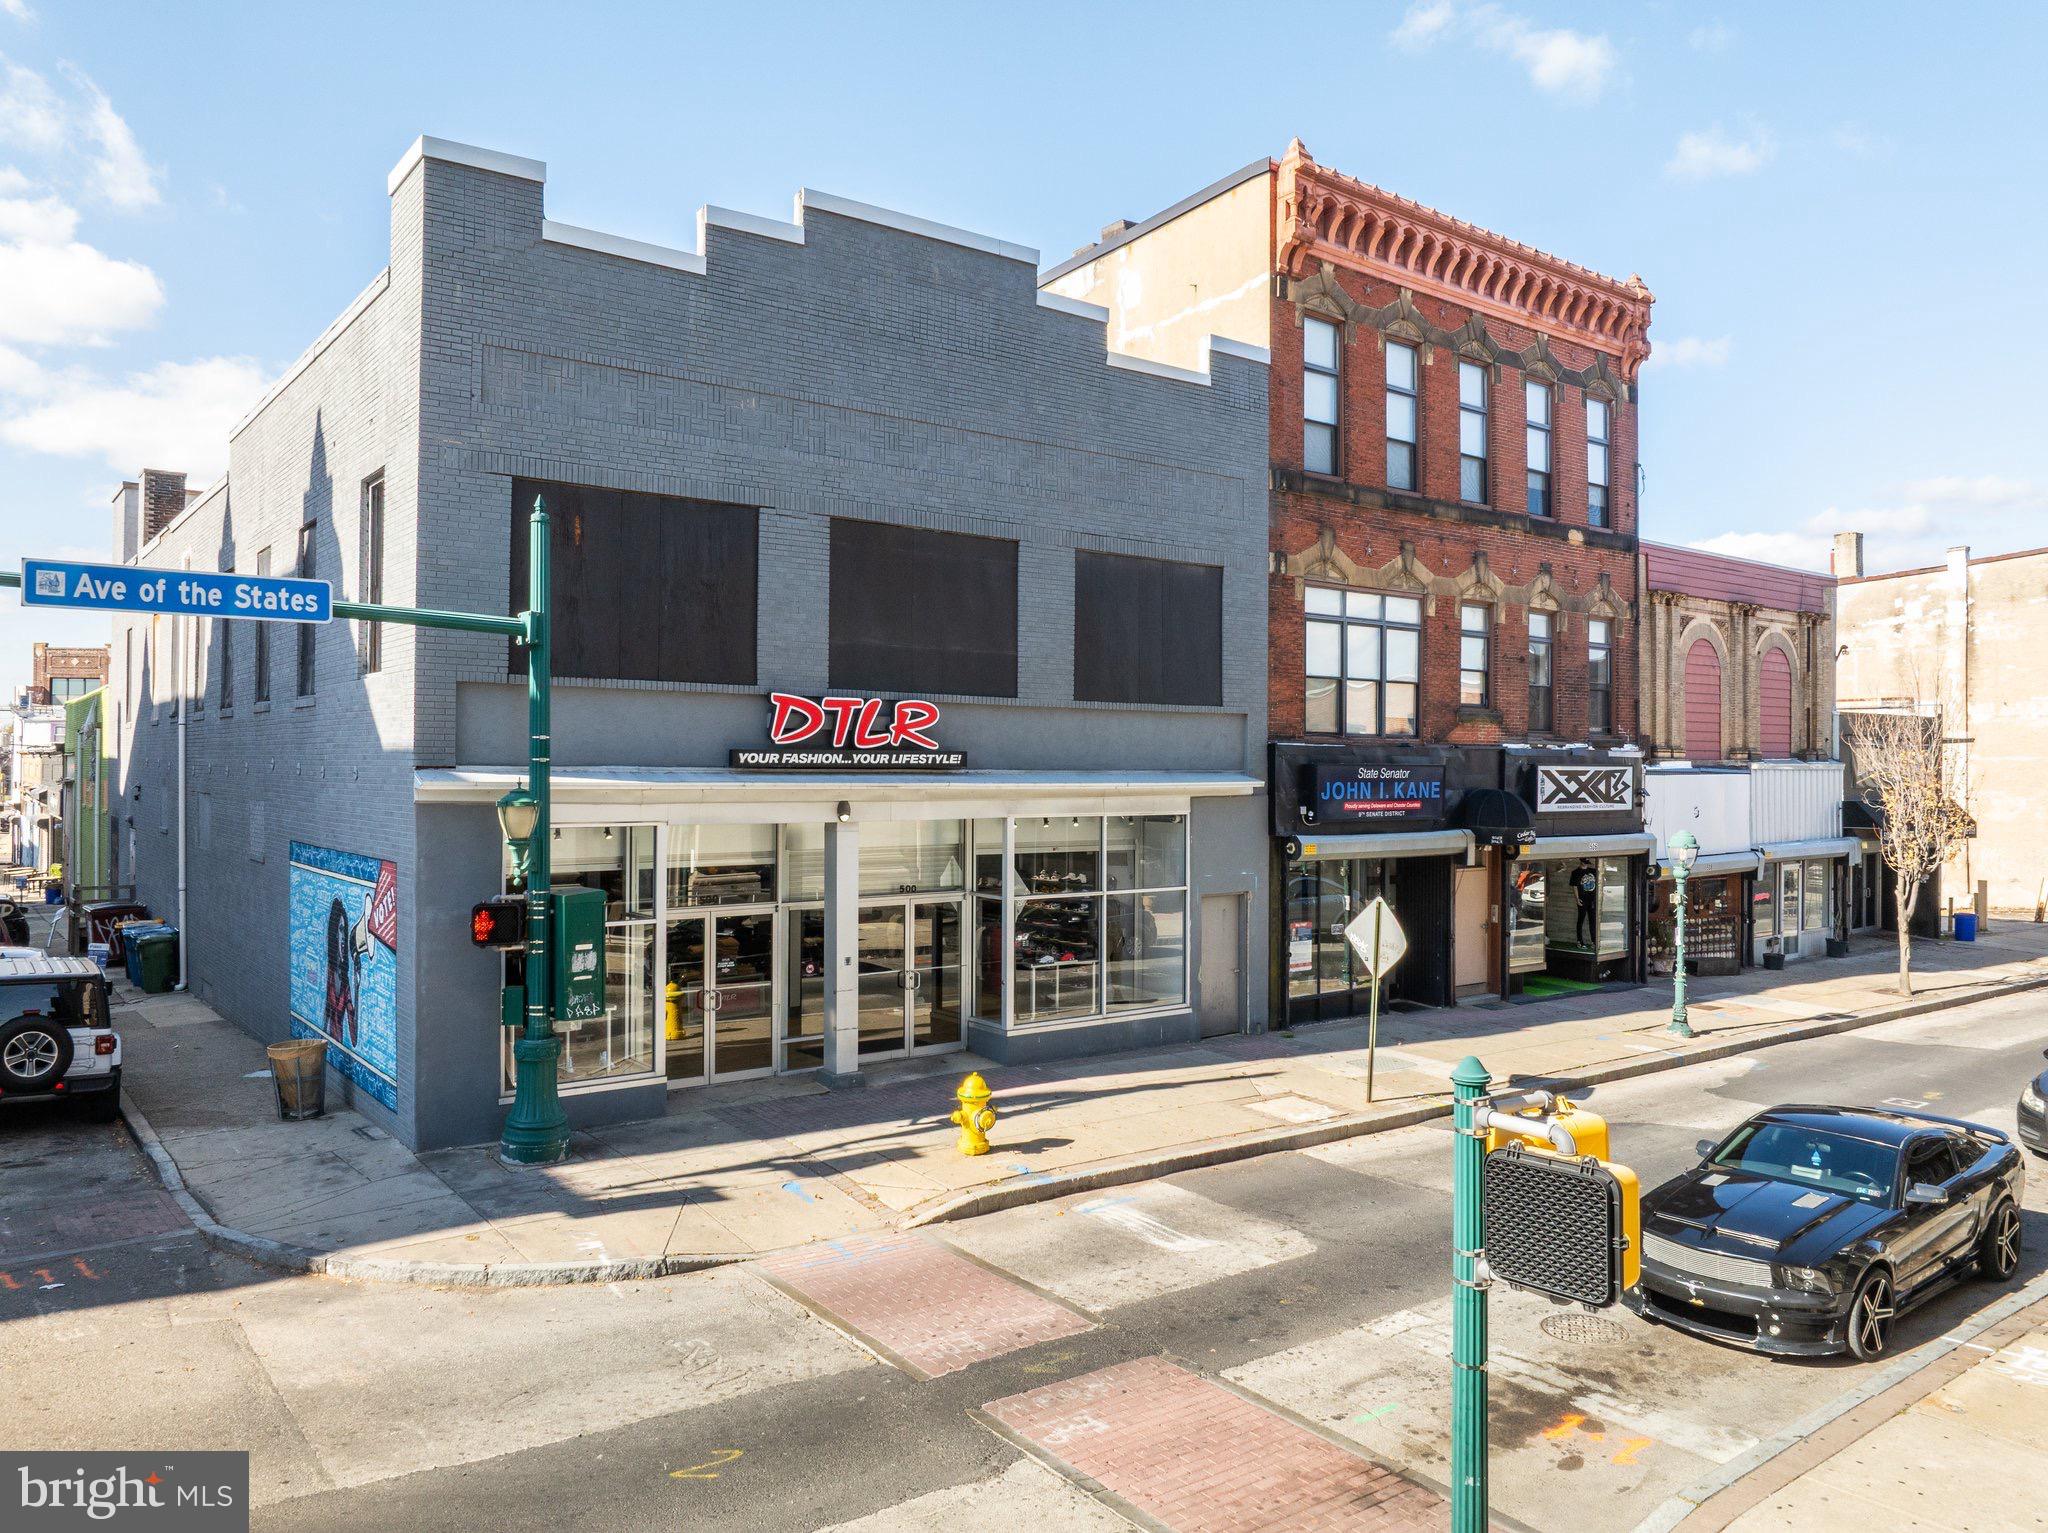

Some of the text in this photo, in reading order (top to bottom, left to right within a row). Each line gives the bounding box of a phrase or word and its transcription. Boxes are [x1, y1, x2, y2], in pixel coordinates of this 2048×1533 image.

[73, 573, 318, 613] Ave of the States
[770, 692, 940, 750] DTLR
[738, 752, 779, 764] YOUR
[891, 753, 962, 764] LIFESTYLE!
[1358, 767, 1411, 779] State Senator
[1321, 781, 1440, 800] JOHN I. KANE
[899, 884, 917, 893] 500
[373, 886, 396, 929] VOTE!
